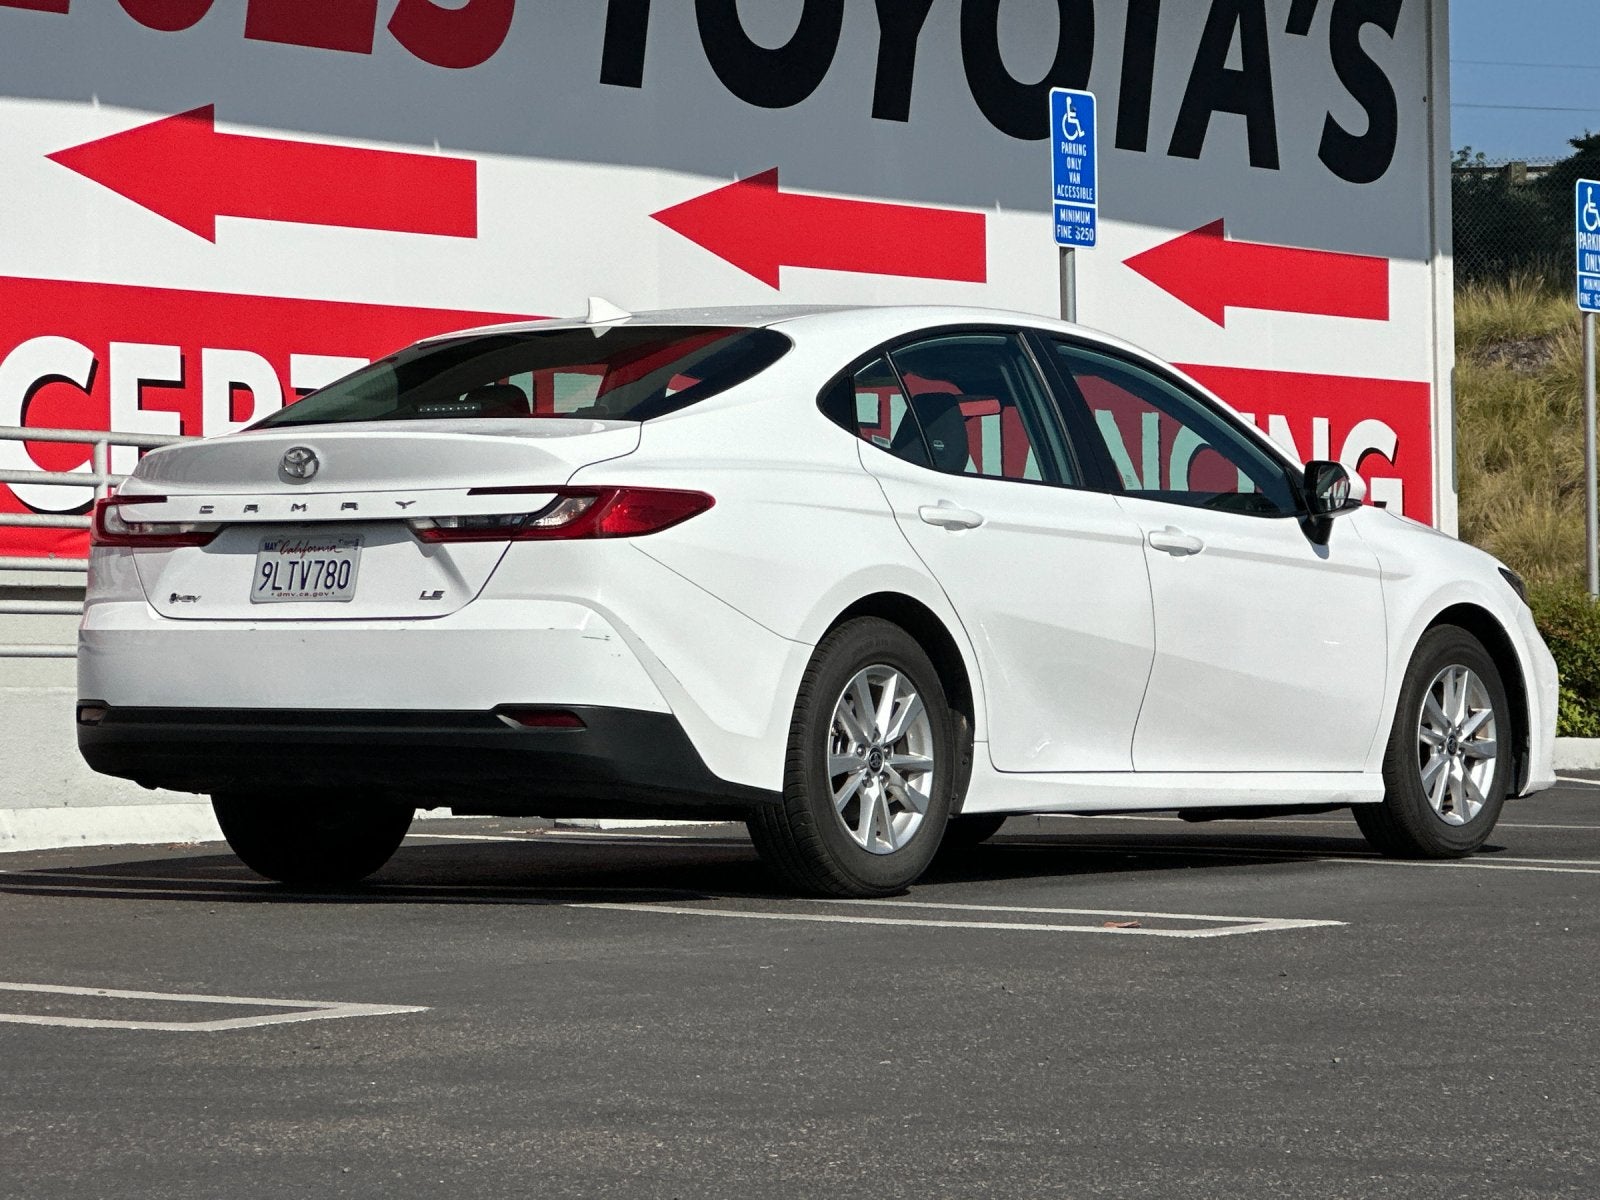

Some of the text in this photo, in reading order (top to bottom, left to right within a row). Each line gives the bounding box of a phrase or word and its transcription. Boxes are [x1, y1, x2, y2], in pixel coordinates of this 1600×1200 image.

[1061, 142, 1087, 157] PARKING
[1066, 157, 1082, 171] ONLY
[1068, 172, 1081, 185] VAN
[1057, 185, 1093, 200] ACCESSIBLE
[1060, 208, 1091, 224] MINIMUM
[1057, 225, 1094, 241] FINE $250
[199, 500, 417, 515] CAMRY
[264, 541, 278, 551] MAY
[279, 540, 342, 559] California
[259, 559, 351, 591] 9LTV780
[419, 590, 445, 601] LE
